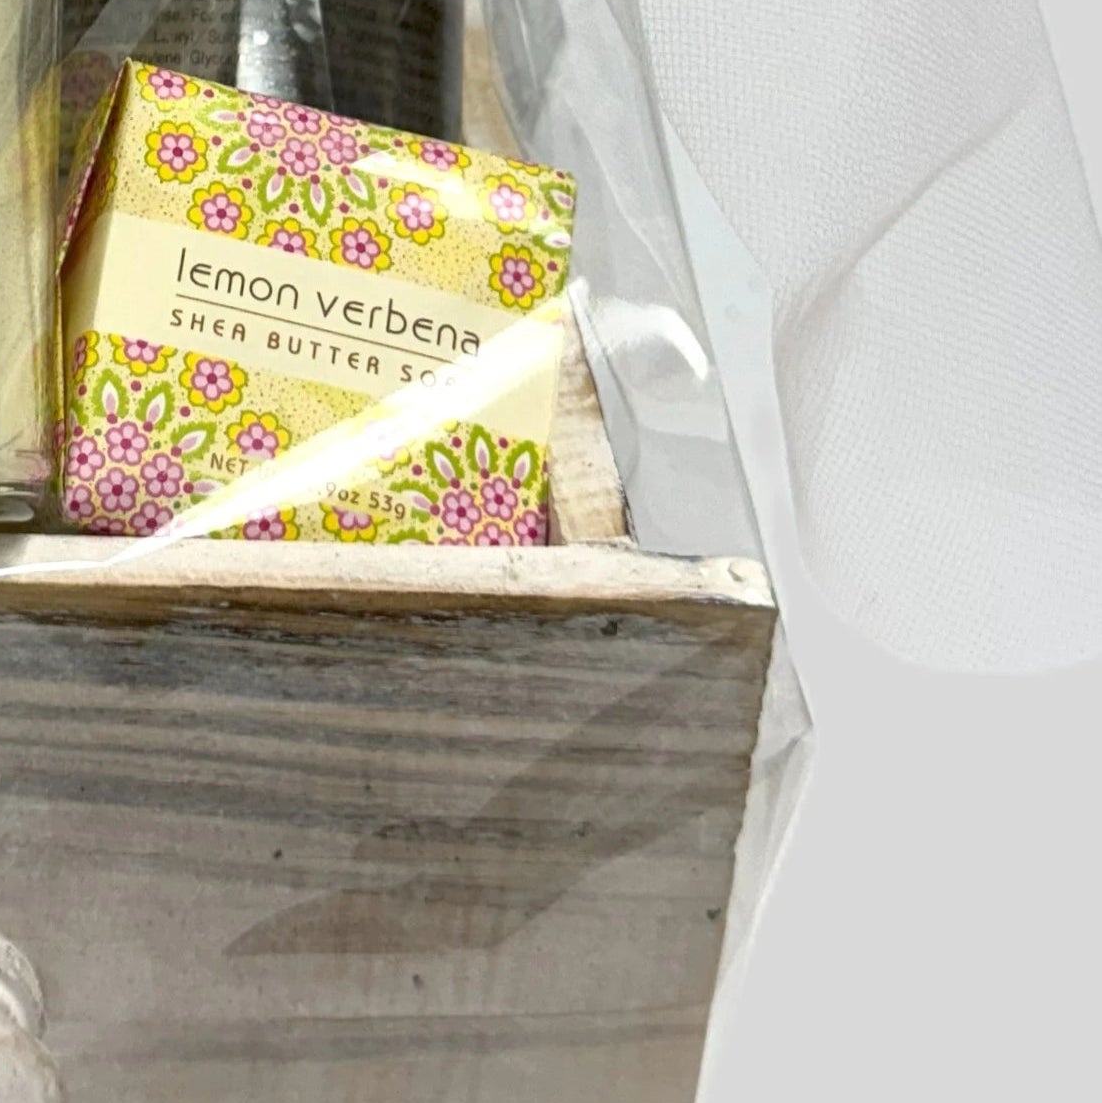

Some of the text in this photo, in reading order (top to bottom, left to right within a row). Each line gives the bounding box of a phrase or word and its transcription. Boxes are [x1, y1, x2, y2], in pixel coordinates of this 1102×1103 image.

[177, 248, 481, 357] lemon verbena
[170, 309, 246, 342] SHEA
[267, 331, 380, 375] BUTTER
[210, 452, 249, 476] NET
[368, 491, 406, 520] 53g
